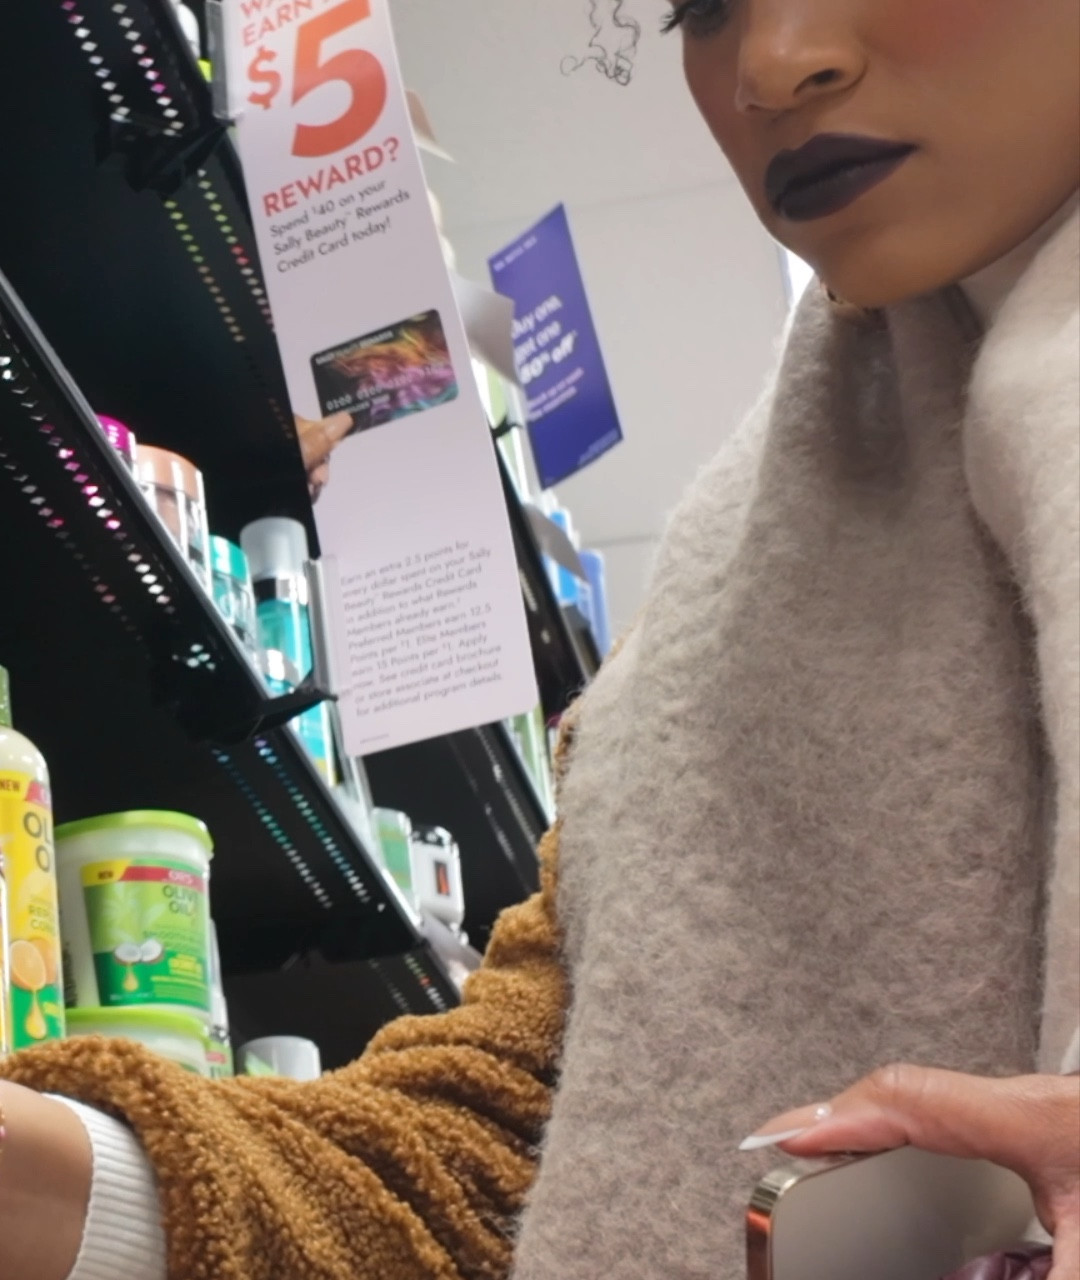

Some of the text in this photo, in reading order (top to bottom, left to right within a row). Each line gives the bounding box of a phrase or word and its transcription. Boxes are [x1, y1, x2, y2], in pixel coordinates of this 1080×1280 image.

[262, 136, 400, 218] REWARD?
[269, 209, 309, 238] Spend
[338, 193, 355, 207] on
[357, 179, 386, 200] your
[273, 188, 411, 256] Sally Rewards
[276, 215, 391, 274] Credit Card today!
[424, 545, 454, 563] points
[425, 570, 455, 589] Credit
[458, 561, 482, 579] Card
[0, 778, 21, 793] NEW
